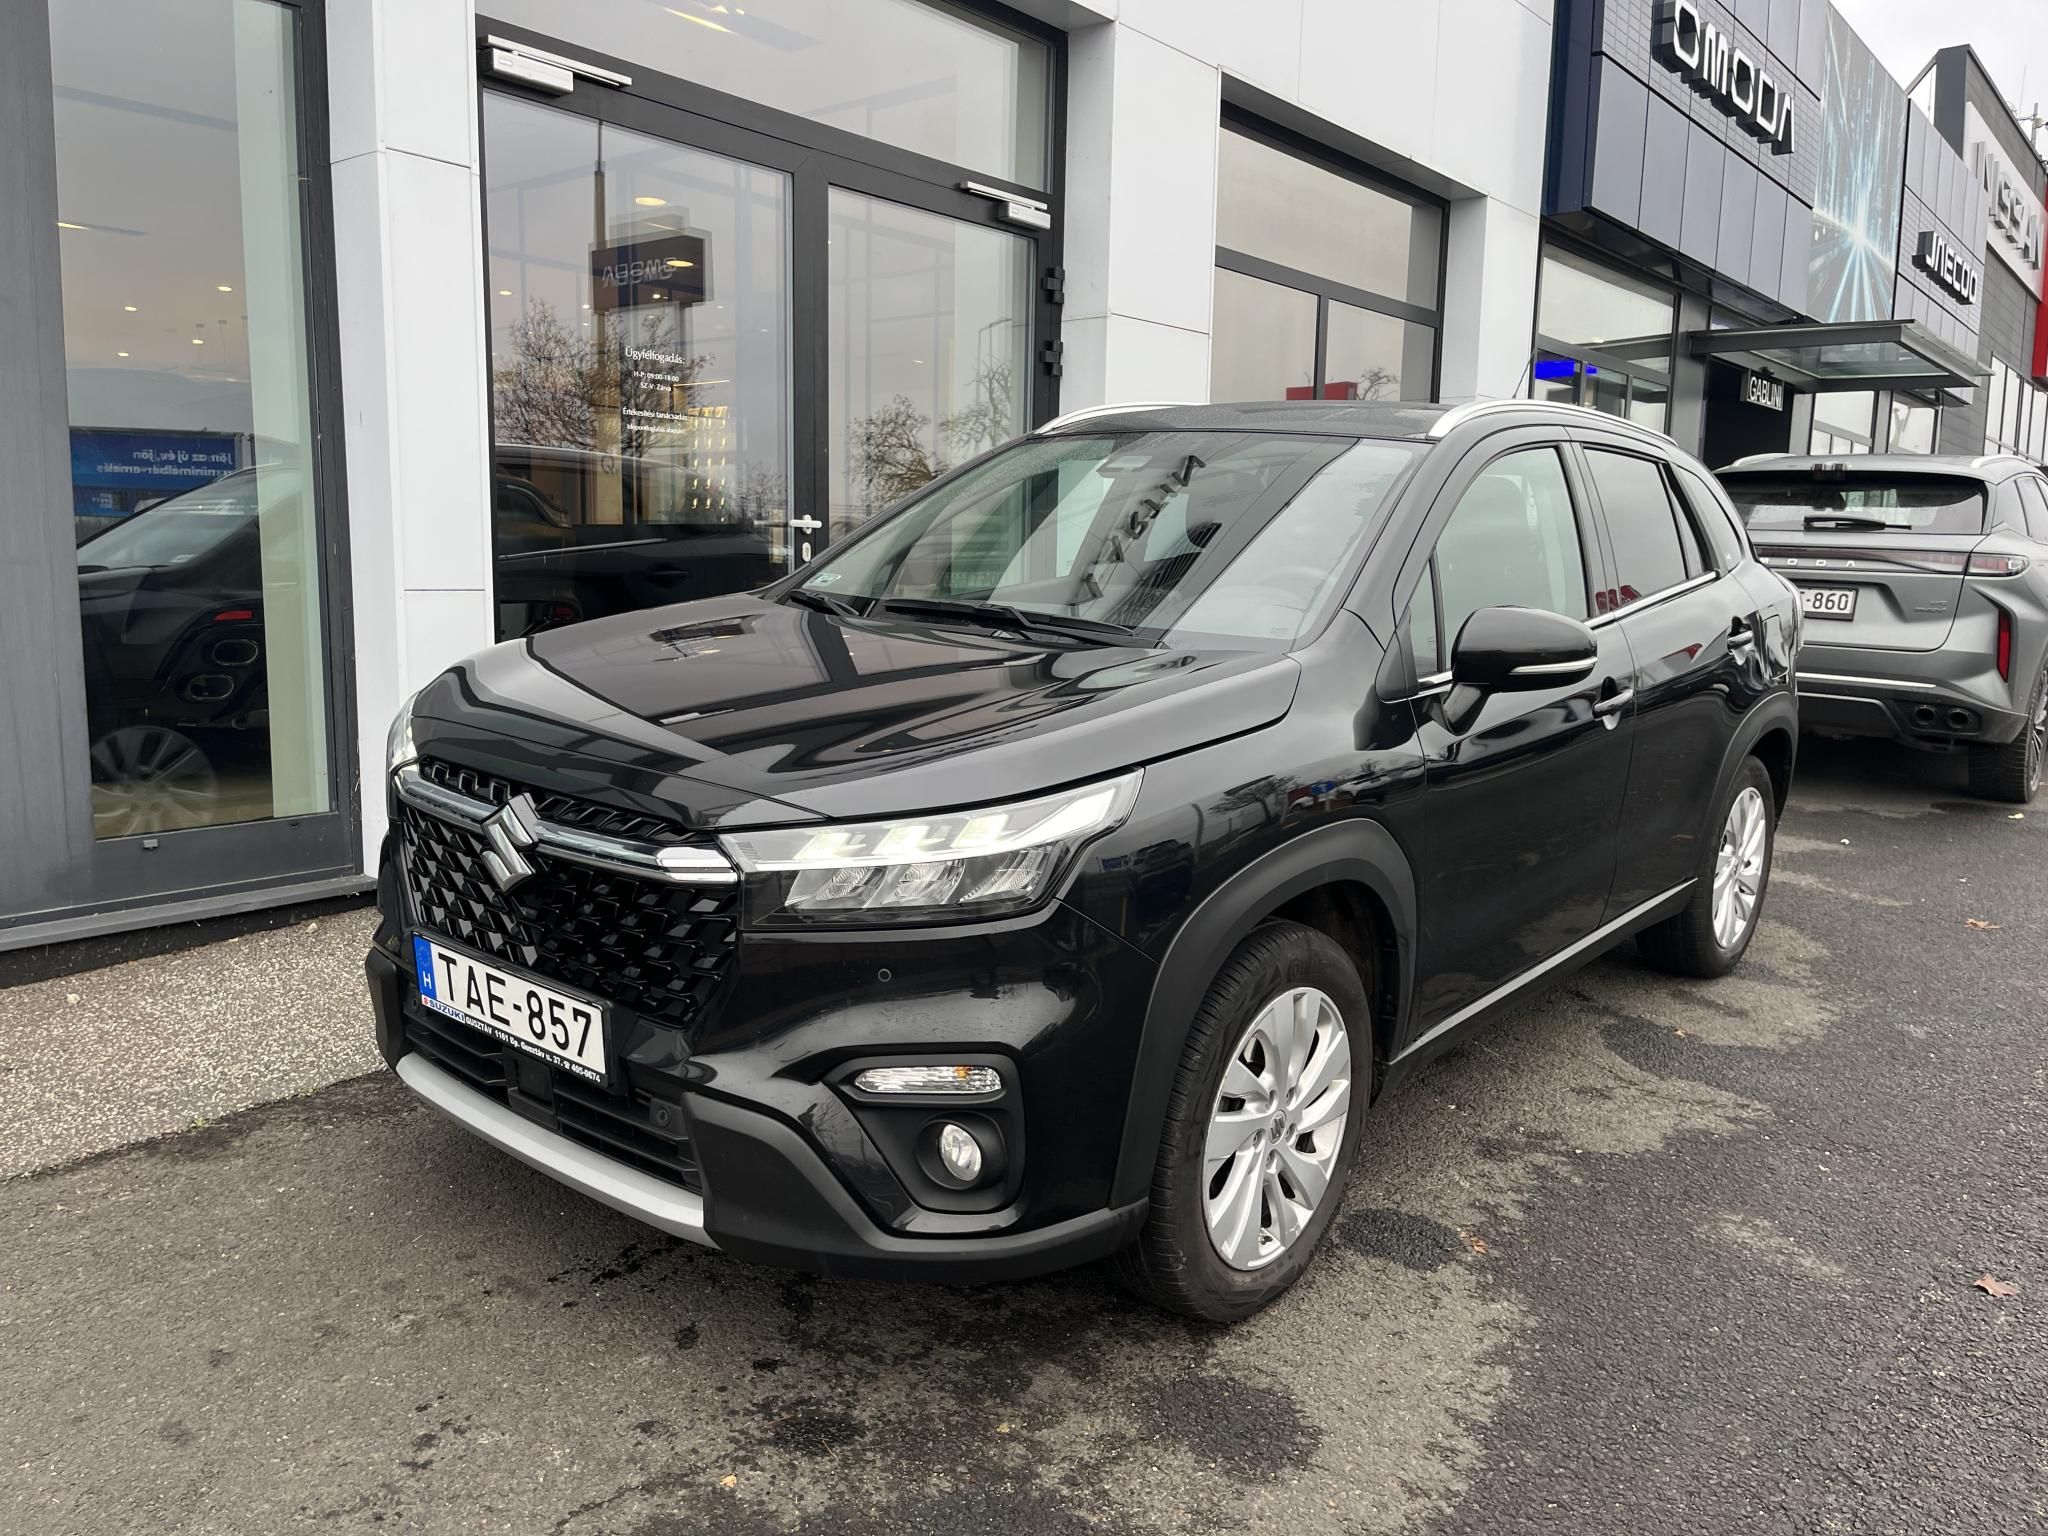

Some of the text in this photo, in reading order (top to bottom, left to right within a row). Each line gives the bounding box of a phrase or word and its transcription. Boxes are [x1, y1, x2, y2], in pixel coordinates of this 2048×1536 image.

[1673, 0, 1795, 153] OMODA
[1973, 141, 2044, 270] NISSAN
[1925, 230, 1978, 304] JAECOO
[625, 345, 685, 364] Ügyfélfogadás:
[1750, 376, 1782, 409] GABLINI
[422, 971, 432, 989] H
[438, 952, 591, 1058] TAE-857
[429, 1000, 465, 1021] SUZUKI
[465, 1017, 493, 1035] GUSZTÁV
[520, 1041, 545, 1058] Gusztáv
